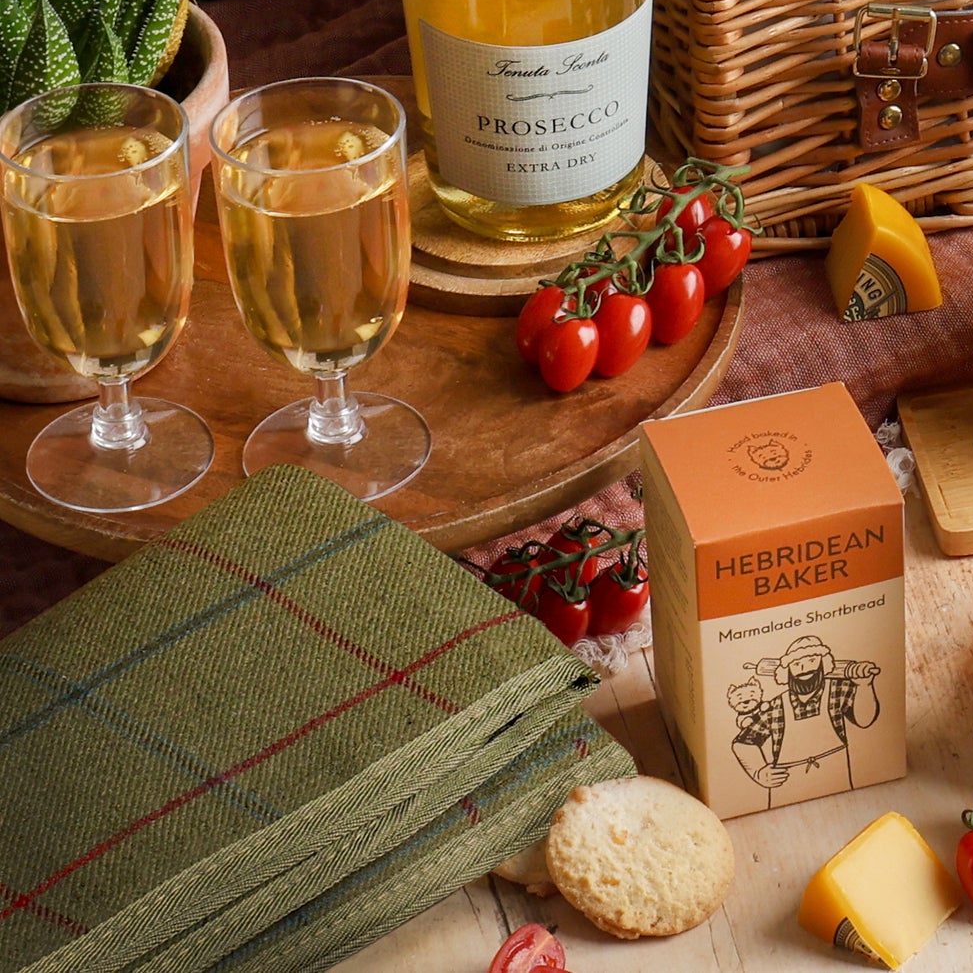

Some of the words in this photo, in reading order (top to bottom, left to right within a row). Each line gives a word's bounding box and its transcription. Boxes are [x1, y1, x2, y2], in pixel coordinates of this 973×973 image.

[487, 59, 550, 78] Tenuta
[477, 100, 620, 136] PROSECCO
[464, 135, 535, 153] Denominazione
[539, 144, 548, 152] di
[551, 138, 587, 152] Origine
[506, 160, 560, 173] EXTRA
[567, 152, 599, 169] DRY
[726, 435, 751, 453] Hand
[751, 430, 789, 439] baked
[788, 433, 798, 441] in
[748, 473, 780, 482] Outer
[782, 449, 813, 480] Hebrides
[715, 525, 885, 580] HEBRIDEAN
[754, 559, 849, 597] BAKER
[718, 617, 802, 643] Marmalade
[805, 594, 886, 624] Shortbread
